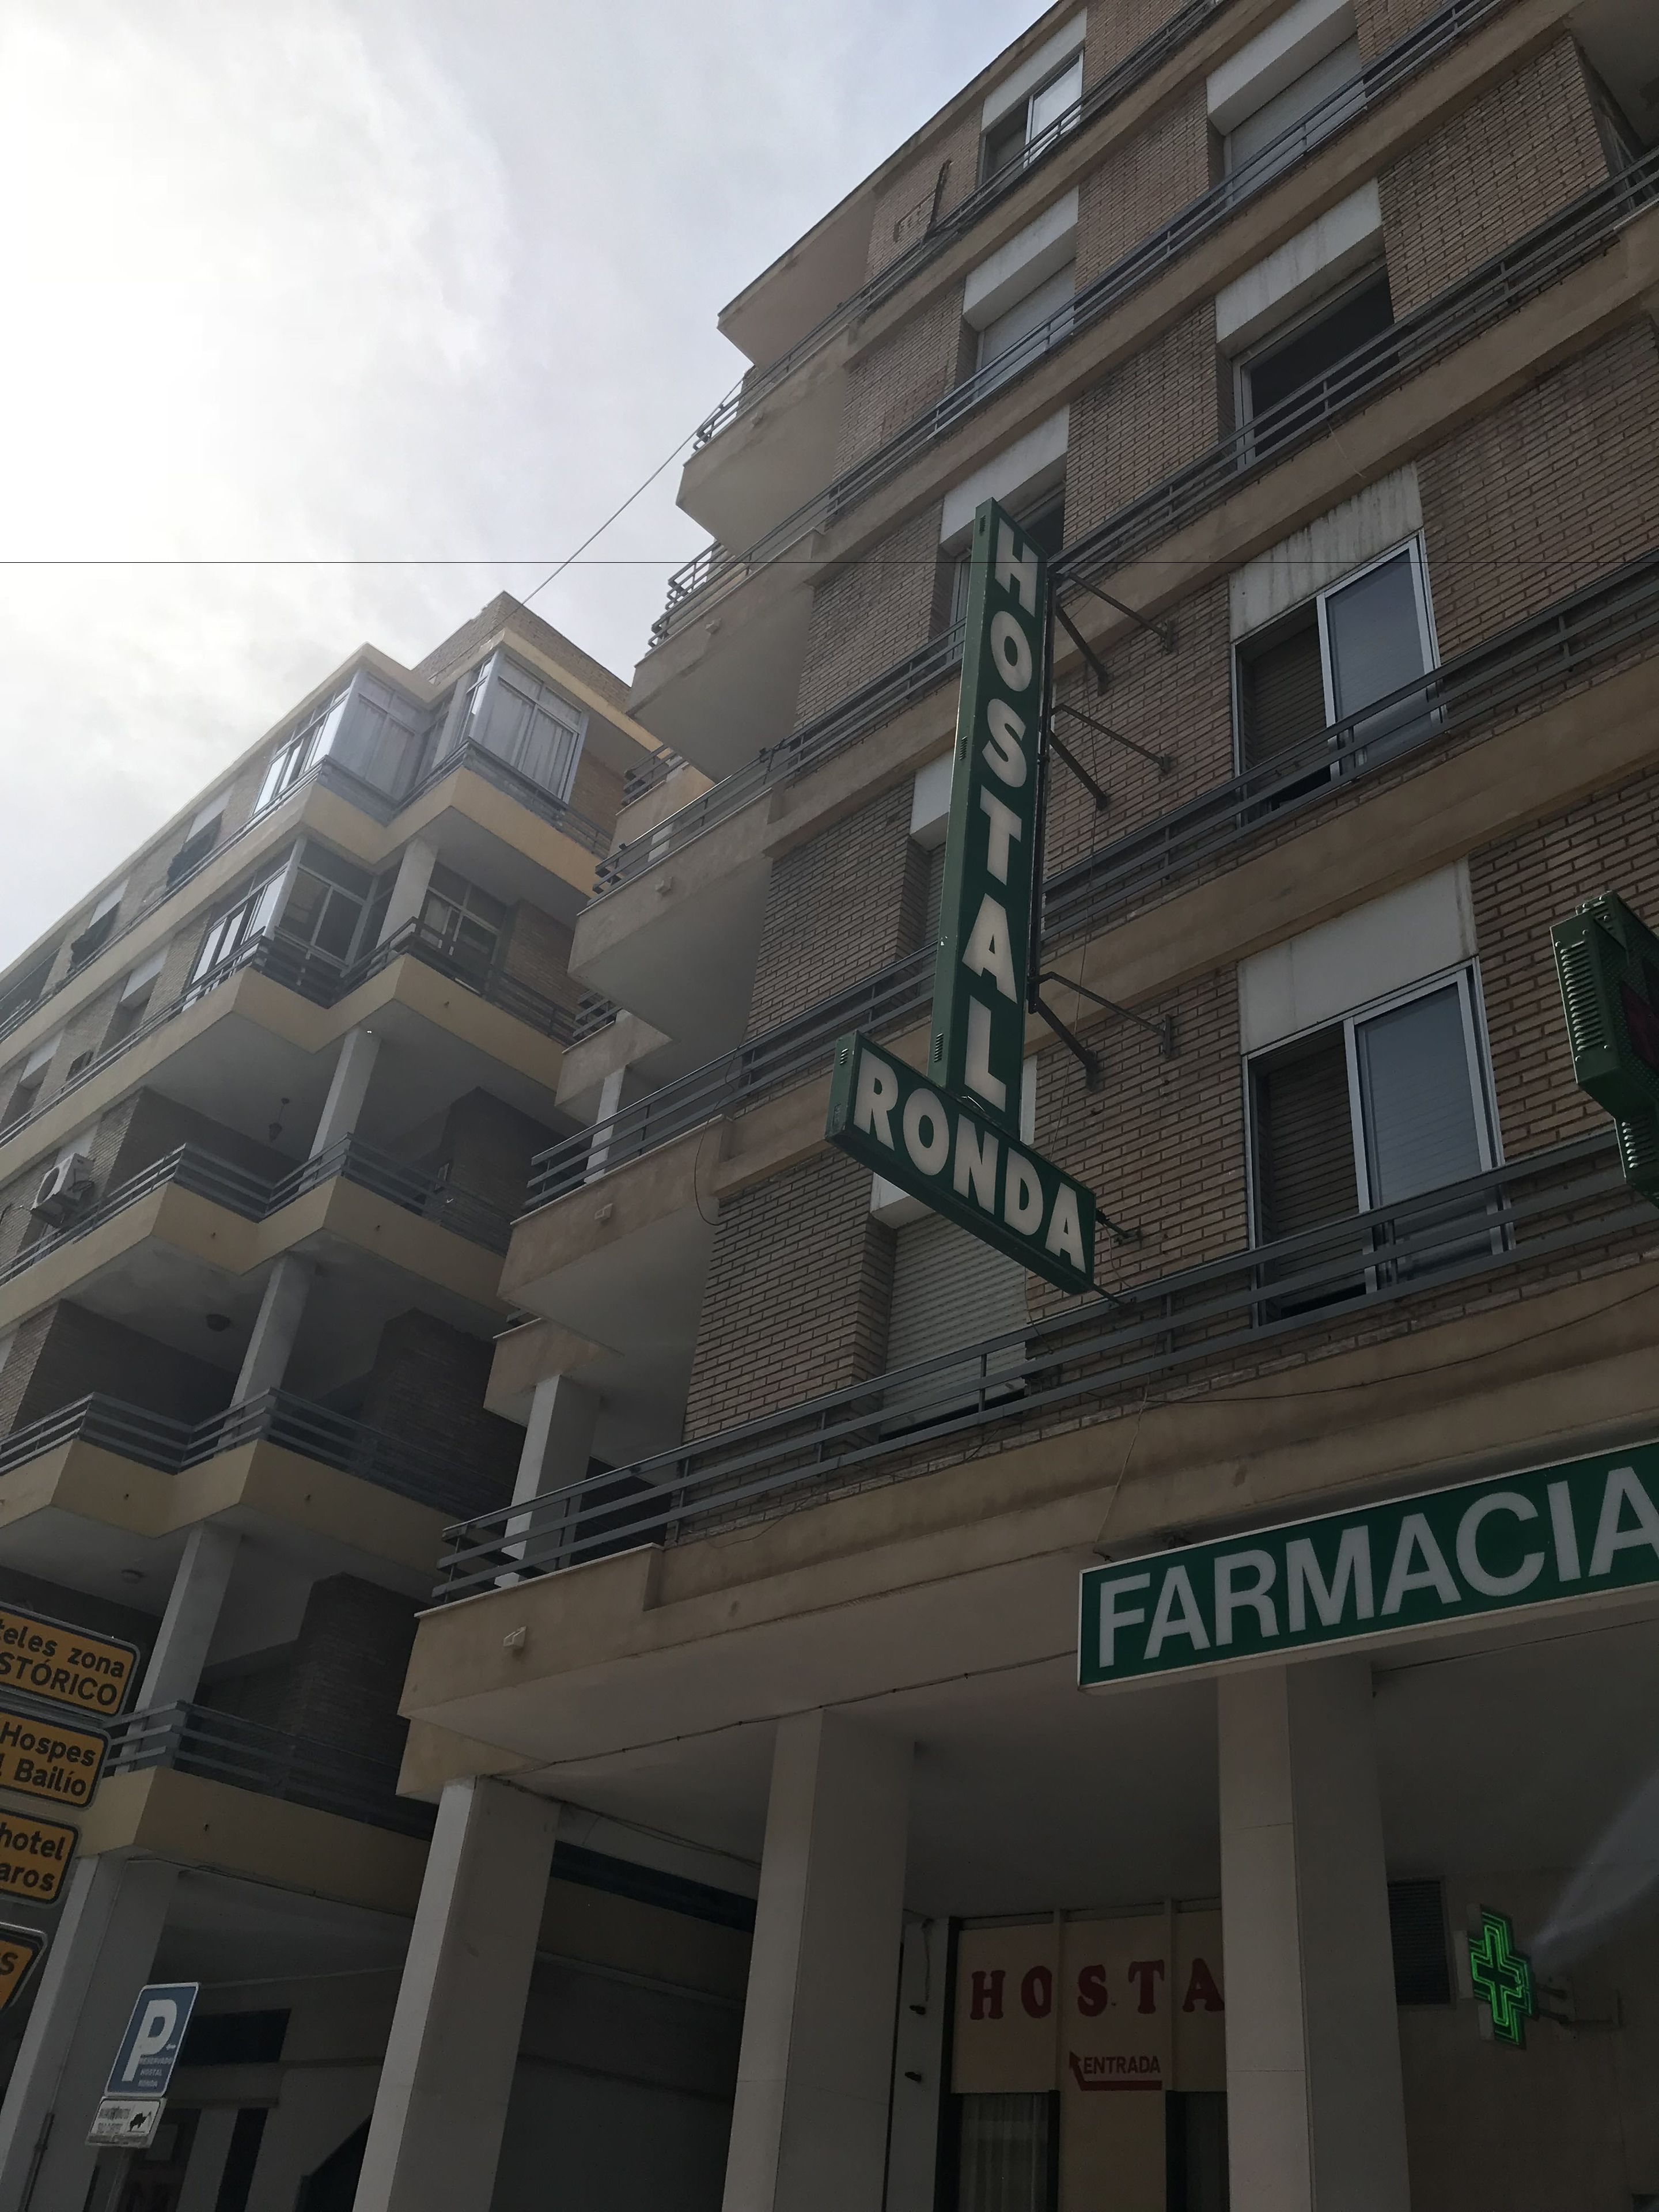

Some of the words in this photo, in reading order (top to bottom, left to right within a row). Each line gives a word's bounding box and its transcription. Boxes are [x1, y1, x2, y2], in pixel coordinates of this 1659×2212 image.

[963, 517, 1037, 1113] HOSTAL
[853, 1047, 1086, 1274] RONDA
[1099, 1465, 1659, 1668] FARMACIA
[0, 1652, 118, 1706] STÓRICO
[67, 1647, 124, 1678] zona
[0, 1721, 96, 1767] Hospes
[14, 1759, 86, 1796] Bailío
[0, 1822, 65, 1861] hotel
[0, 1862, 55, 1891] aros
[969, 1958, 1225, 2020] HOSTA
[122, 1999, 177, 2082] P
[1084, 2055, 1161, 2074] ENTRADA
